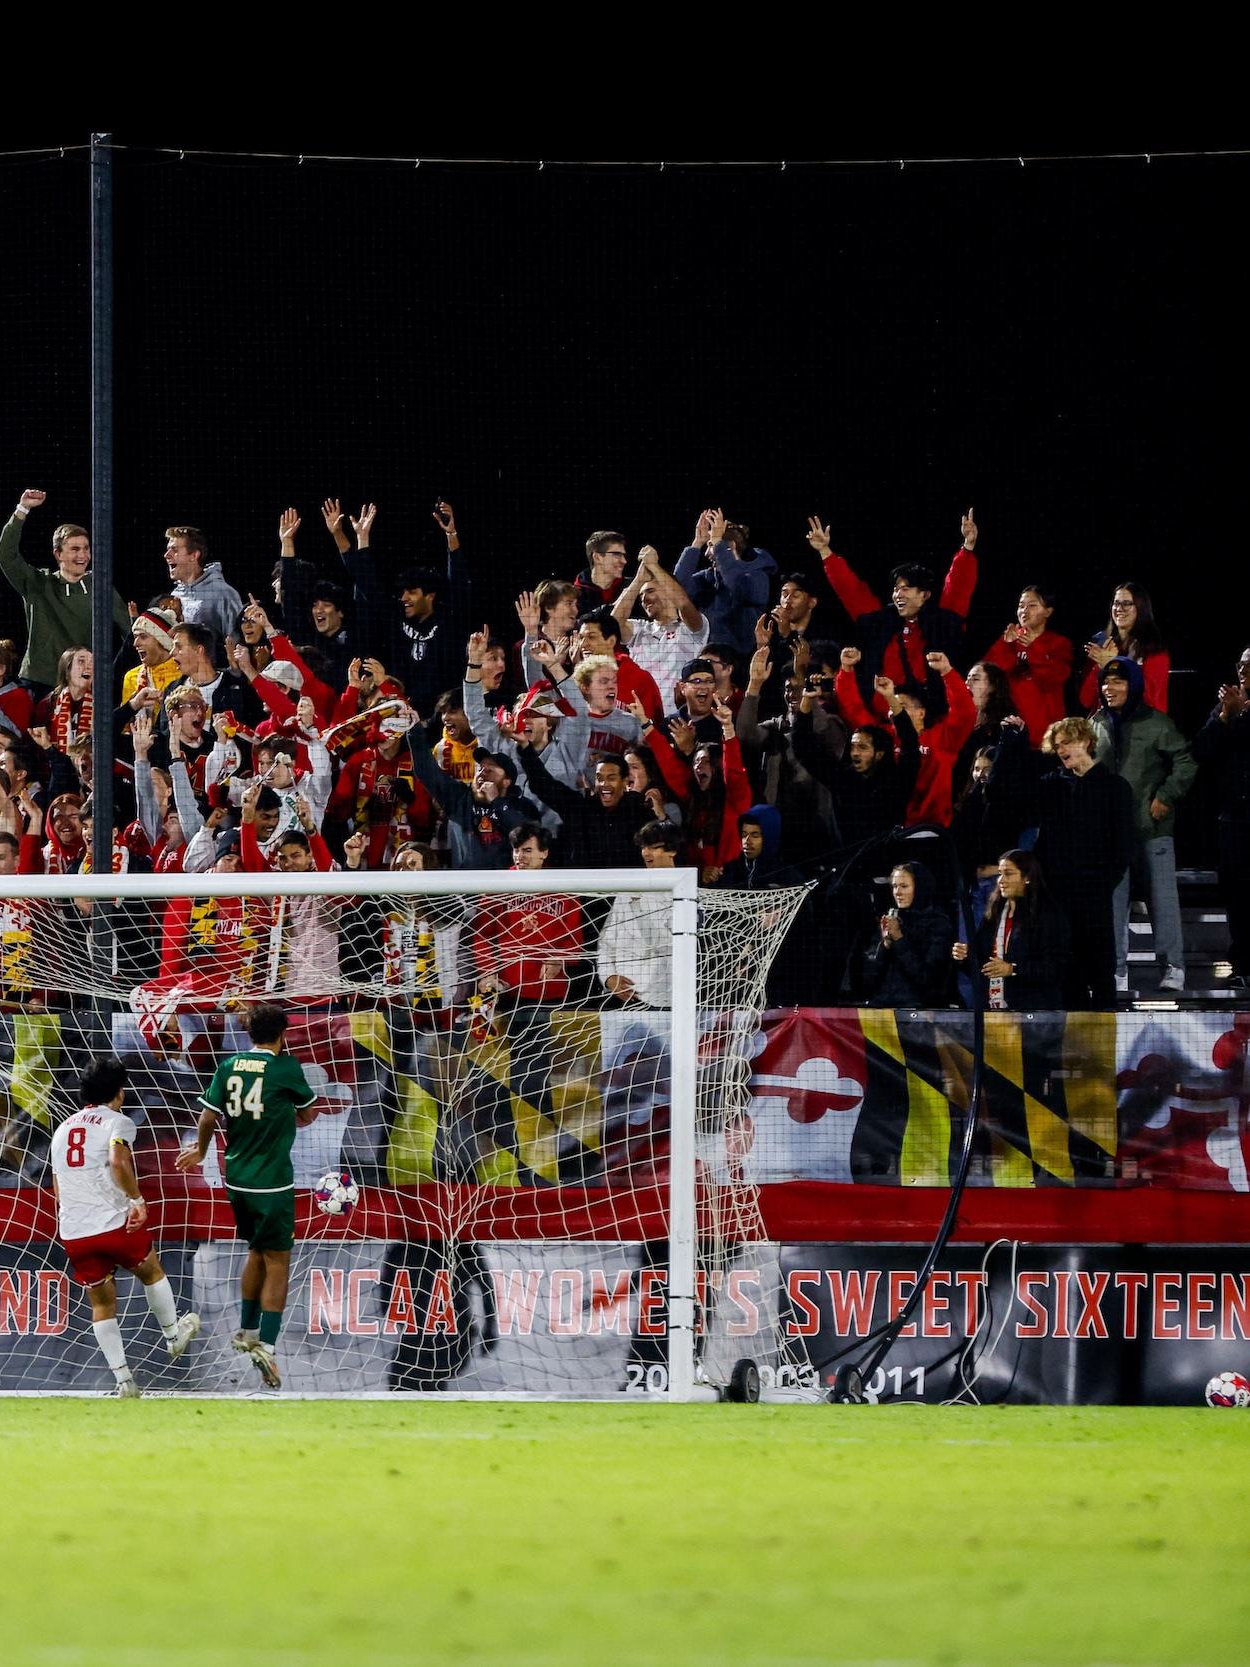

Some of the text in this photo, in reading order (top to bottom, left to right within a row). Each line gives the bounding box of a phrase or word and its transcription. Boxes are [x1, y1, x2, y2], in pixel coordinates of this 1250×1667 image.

[226, 1075, 265, 1120] 34
[66, 1127, 86, 1168] 8
[308, 1268, 458, 1336] NCAA
[786, 1269, 989, 1338] SWEET
[1015, 1270, 1250, 1340] SIXTEEN
[836, 1366, 926, 1395] 011
